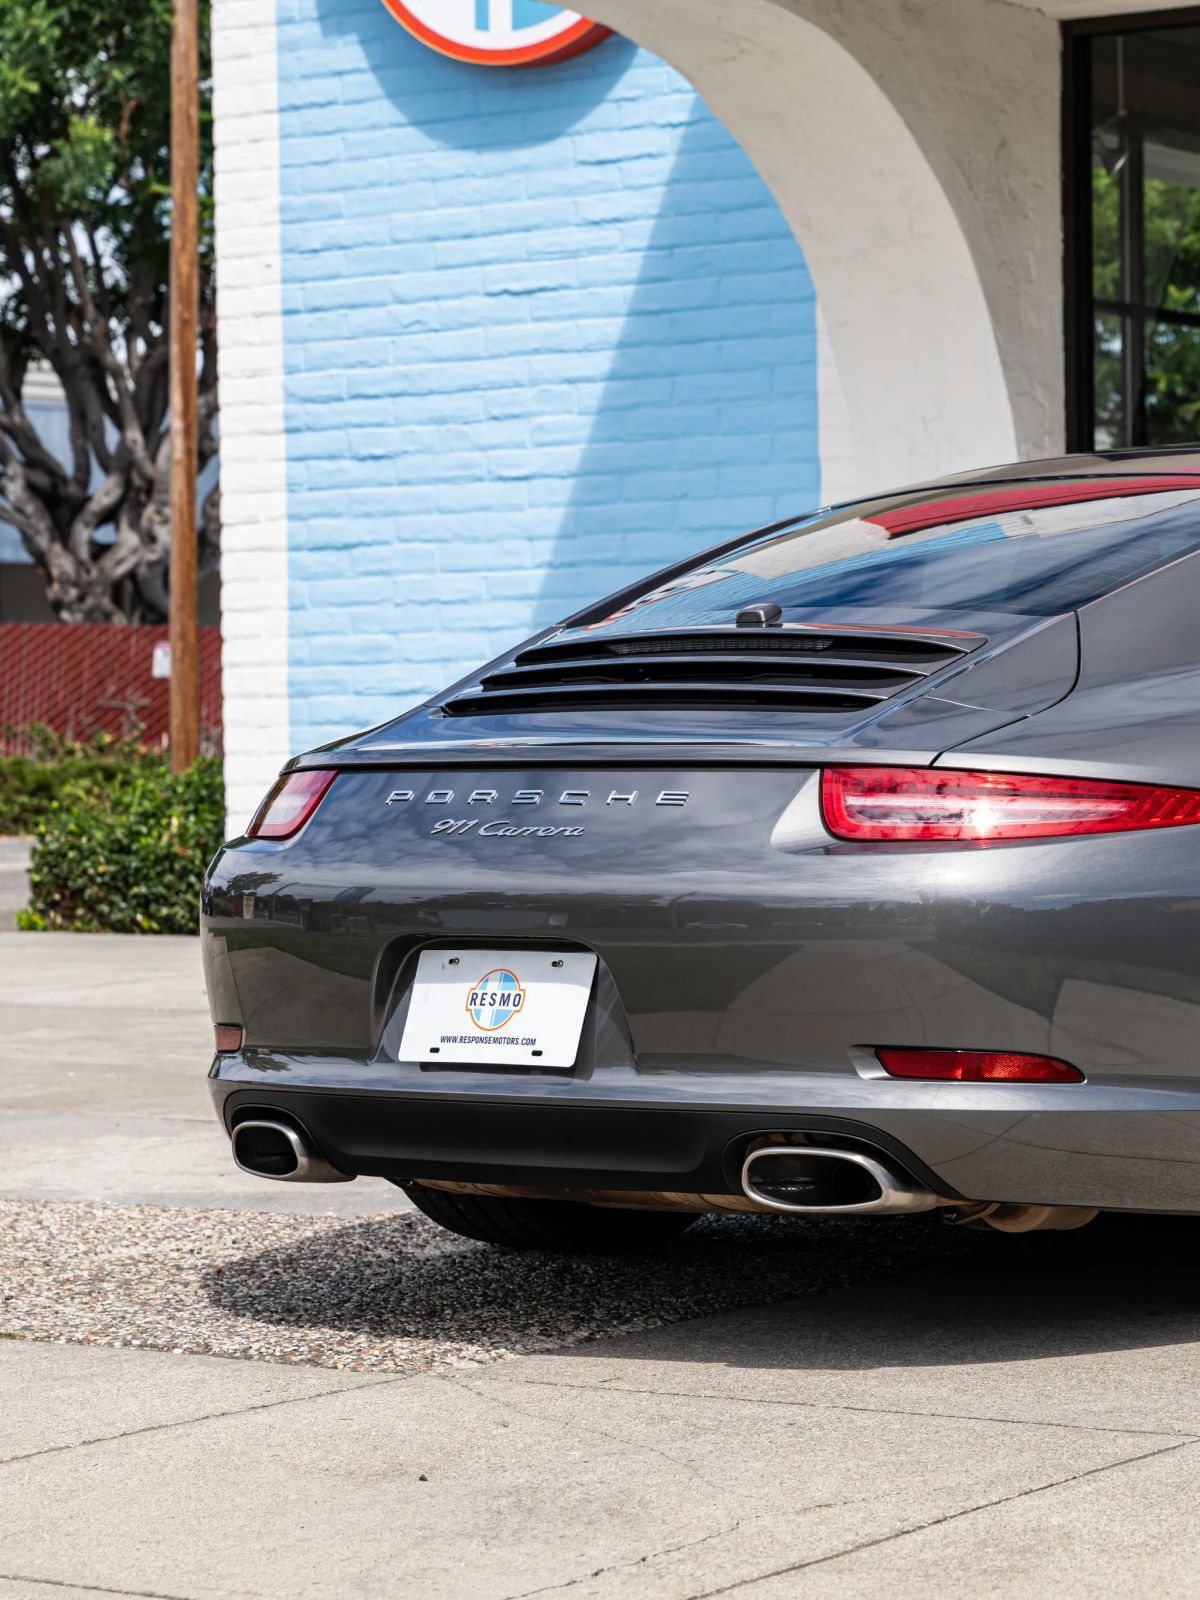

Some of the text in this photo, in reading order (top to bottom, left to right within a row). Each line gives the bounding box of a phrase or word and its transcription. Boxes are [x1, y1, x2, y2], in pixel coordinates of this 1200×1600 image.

[385, 789, 690, 807] PORSCHE
[430, 818, 587, 837] 911 Carrera
[469, 992, 522, 1008] RESMO
[440, 1035, 537, 1046] WWW.RESPONSEMOTORS.COM
